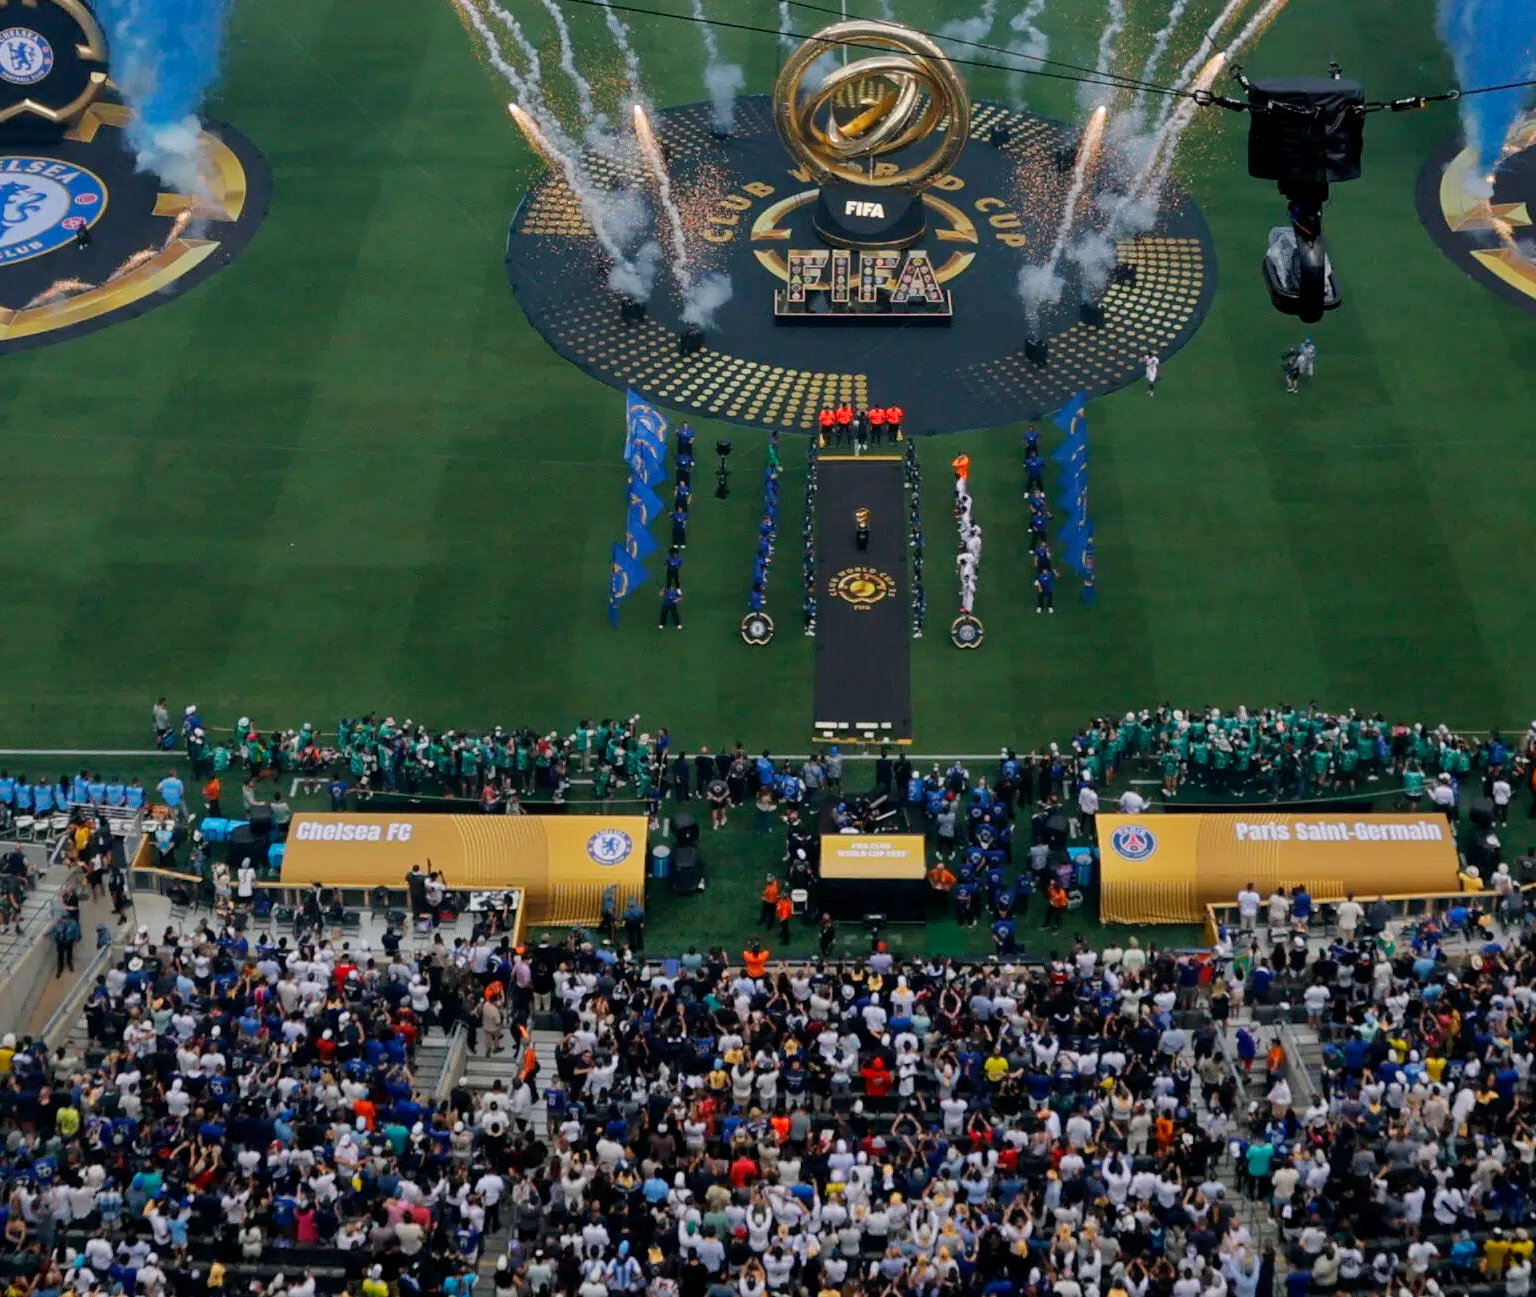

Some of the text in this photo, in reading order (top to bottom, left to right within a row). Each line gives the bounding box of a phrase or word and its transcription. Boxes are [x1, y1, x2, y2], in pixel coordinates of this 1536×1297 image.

[702, 182, 775, 243] CLUB
[975, 197, 1027, 247] CUP
[845, 200, 885, 219] FIFA
[787, 250, 944, 302] FIFA
[296, 821, 412, 841] Chelsea FC
[1235, 821, 1442, 841] Paris Saint-Germain
